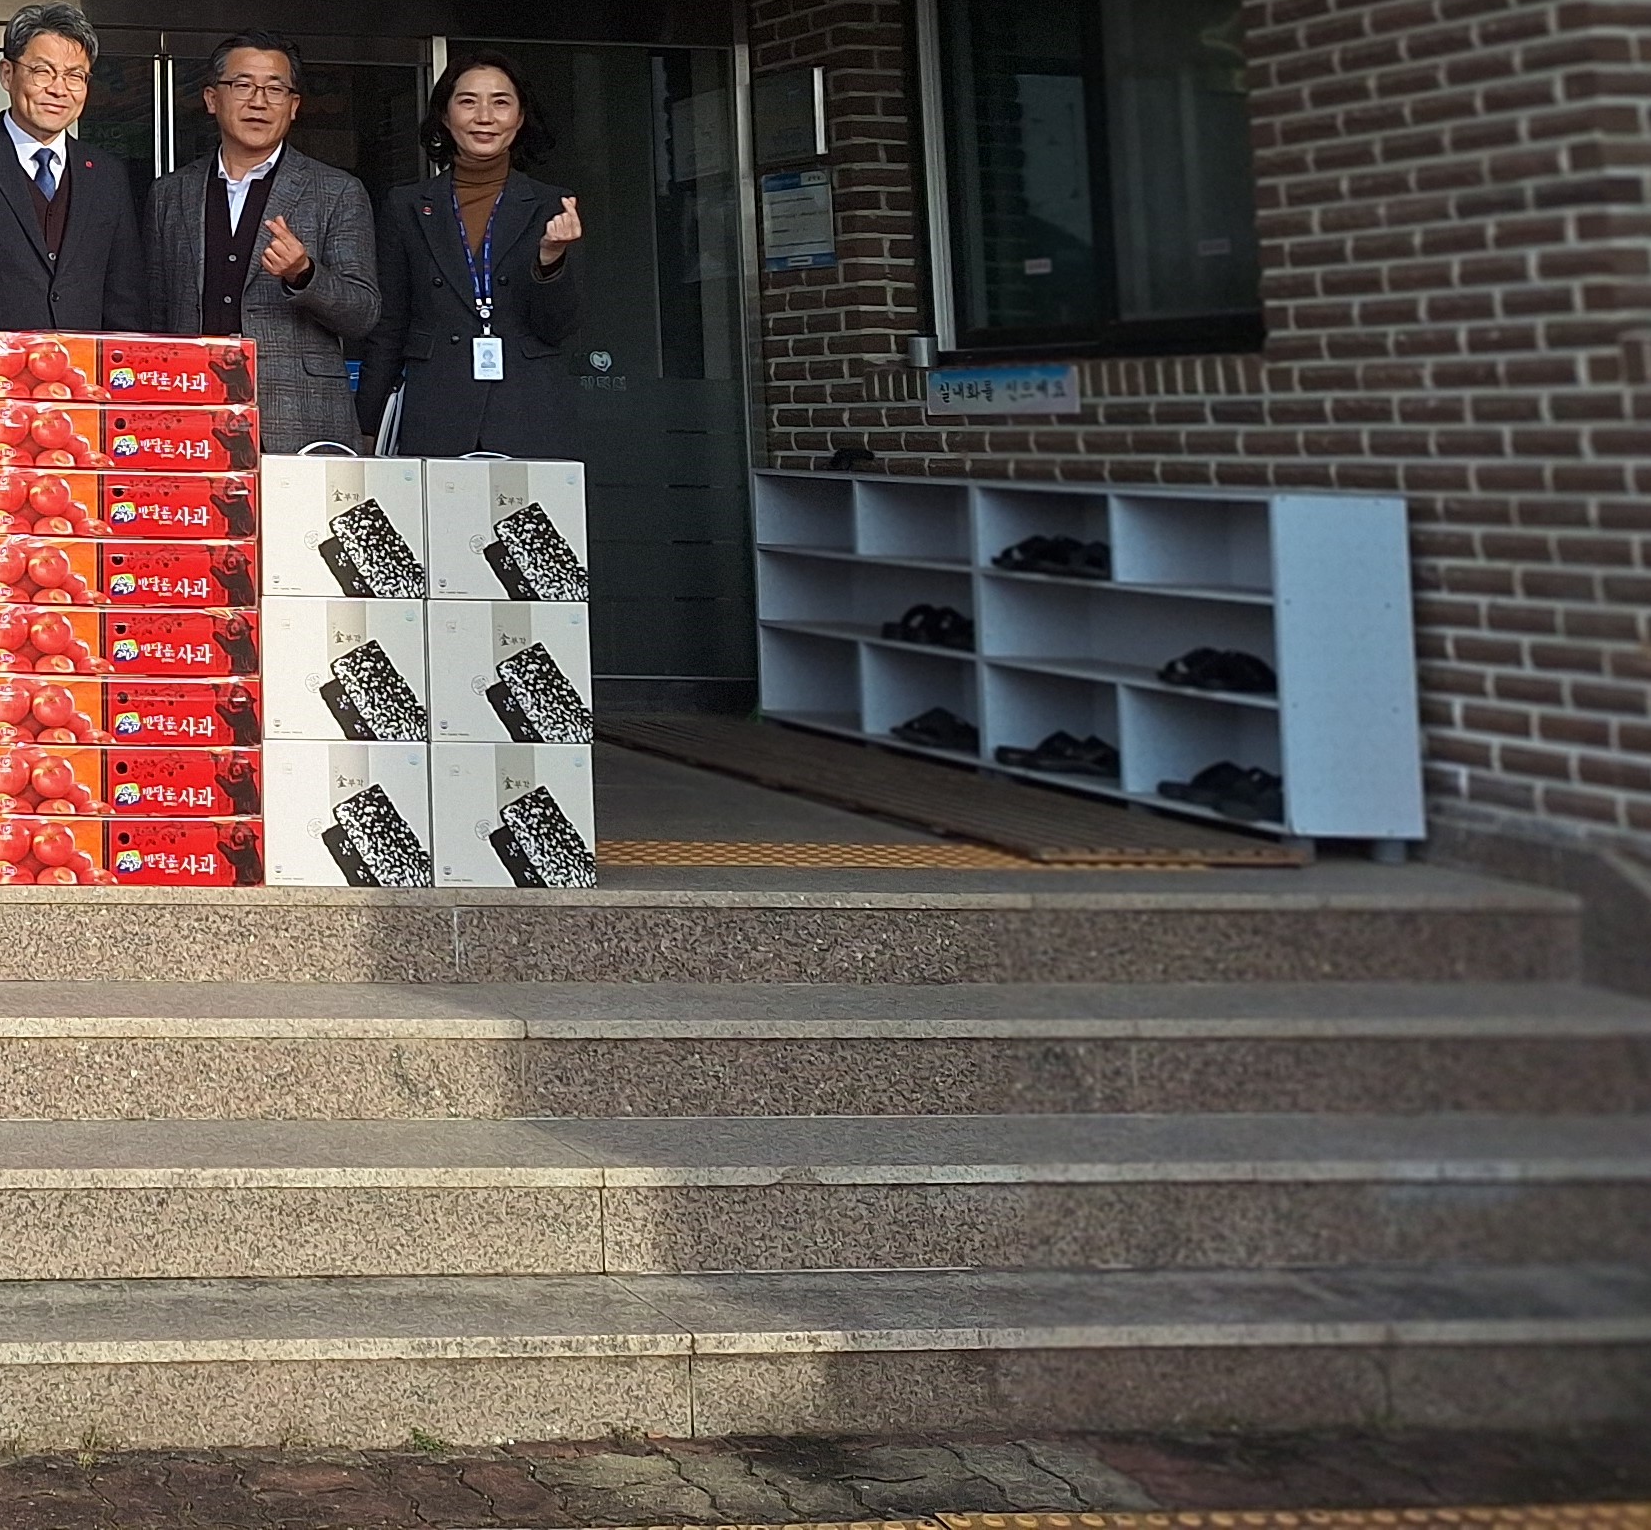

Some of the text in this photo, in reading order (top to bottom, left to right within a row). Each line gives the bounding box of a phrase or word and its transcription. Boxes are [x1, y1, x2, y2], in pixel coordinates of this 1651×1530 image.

[137, 372, 208, 392] 반달곰 사과
[940, 379, 1067, 403] 실내화를 신으세요
[140, 438, 212, 459] 반달곰 사과
[138, 505, 210, 526] 반달곰 사과
[138, 577, 210, 598] 반달곰 사과
[140, 642, 213, 664] 반달곰 사과
[142, 715, 215, 737] 반달곰 사과
[142, 785, 215, 808] 반달곰 사과
[144, 853, 217, 875] 반달곰 사과
